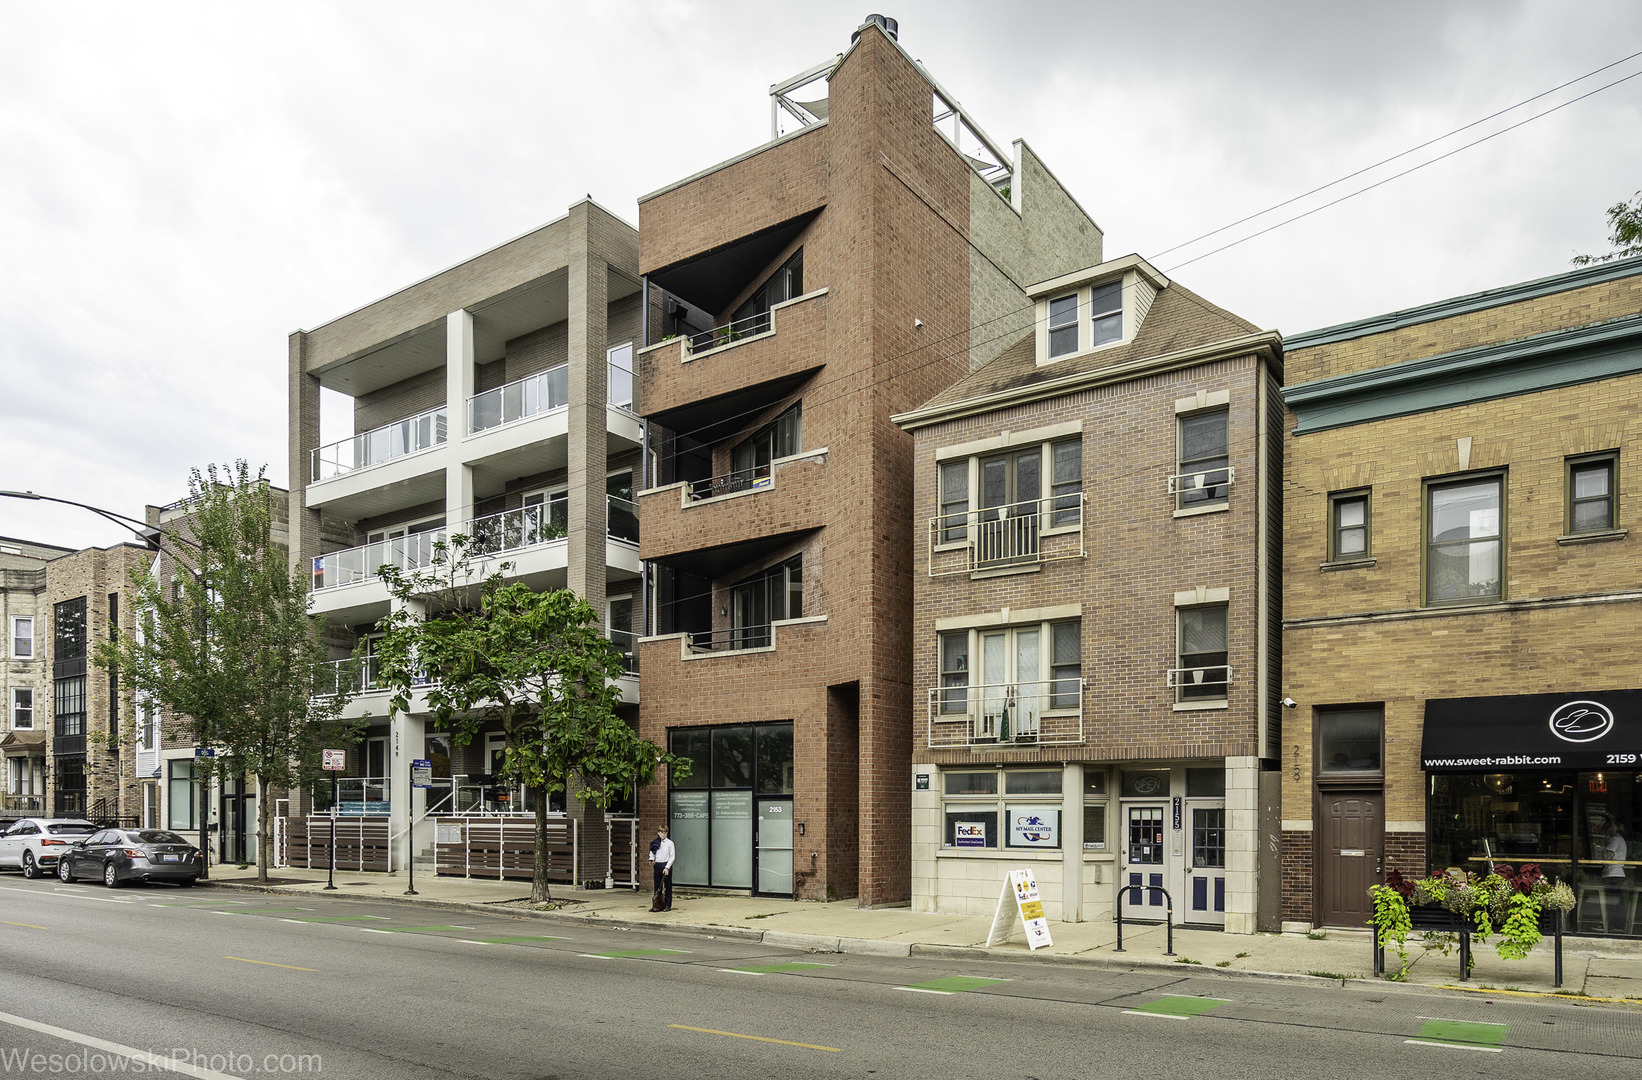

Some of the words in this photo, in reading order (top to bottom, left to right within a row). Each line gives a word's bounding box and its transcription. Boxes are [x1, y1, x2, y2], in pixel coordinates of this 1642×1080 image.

[1424, 754, 1561, 767] www.sweet-rabbit.com
[1606, 754, 1637, 764] 2159
[1135, 779, 1161, 790] OPEN
[958, 826, 983, 836] FedEx
